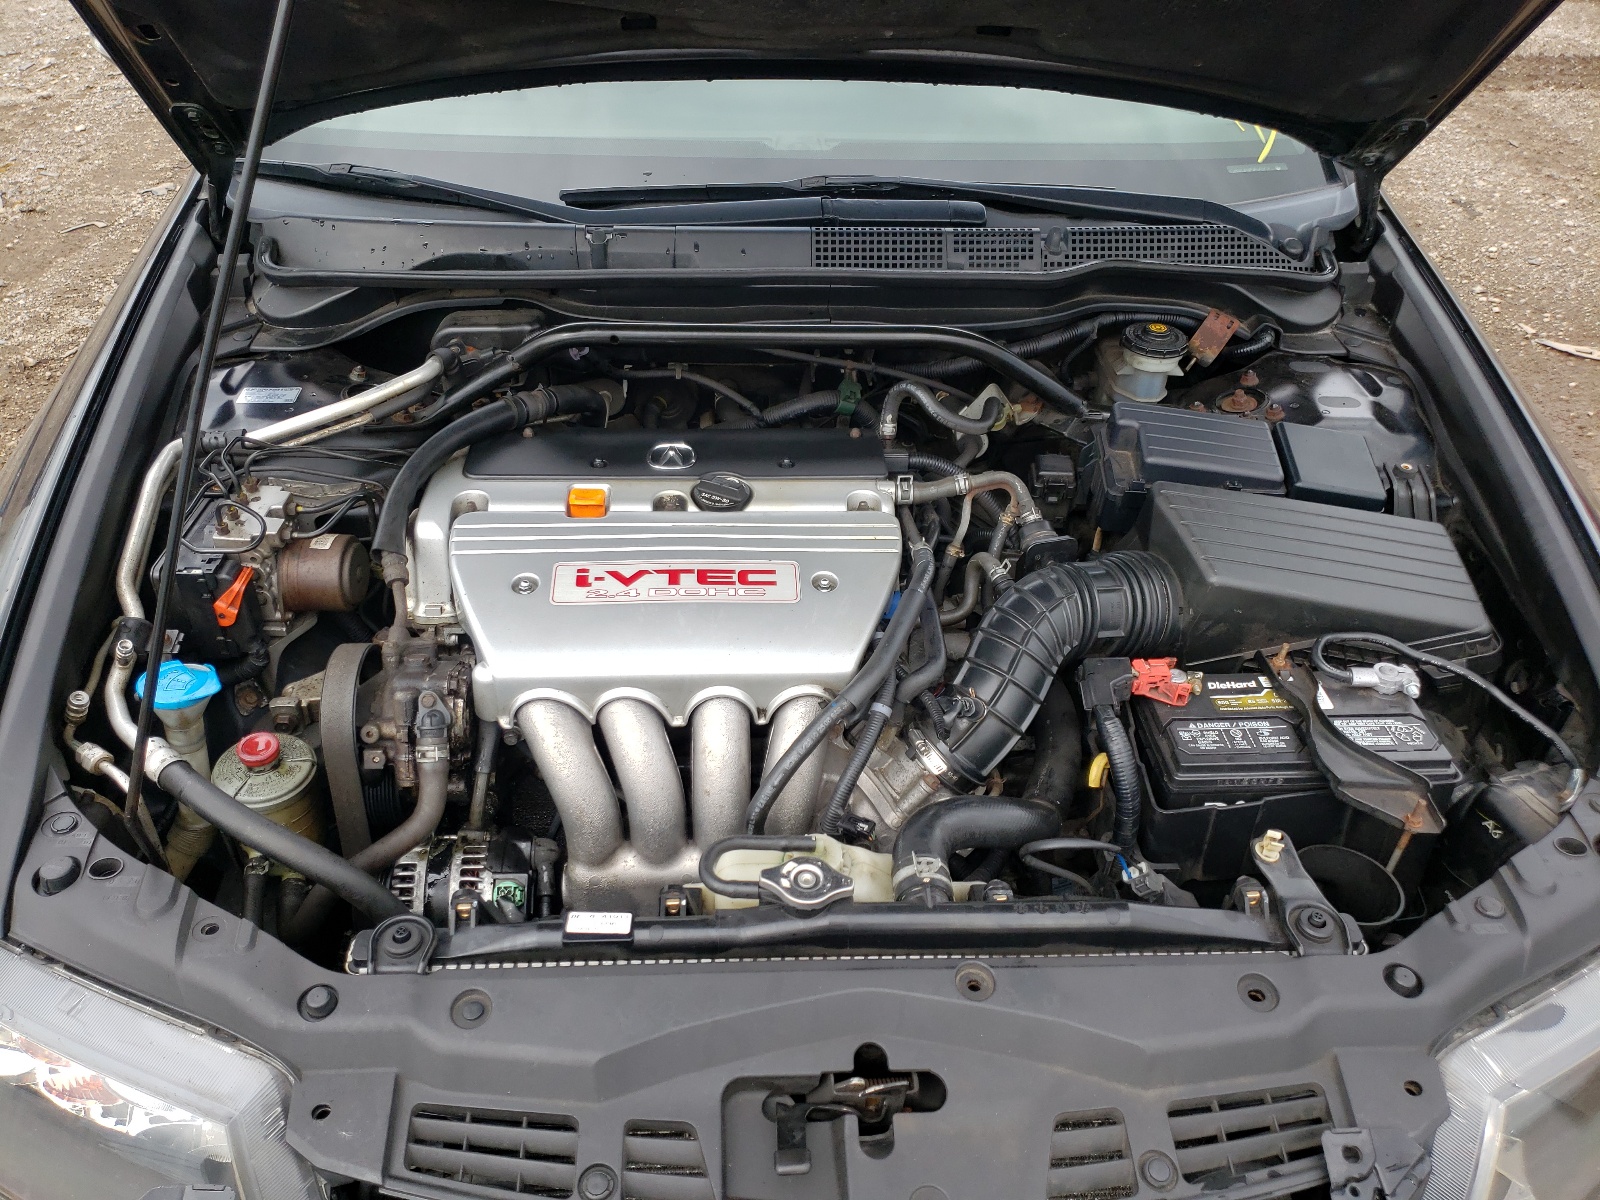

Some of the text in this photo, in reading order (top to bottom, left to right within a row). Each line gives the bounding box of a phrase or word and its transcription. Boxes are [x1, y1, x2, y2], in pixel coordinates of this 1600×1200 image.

[576, 567, 777, 588] i-VTEC
[586, 588, 766, 599] 2.4 DOHC
[1207, 681, 1258, 690] DieHard
